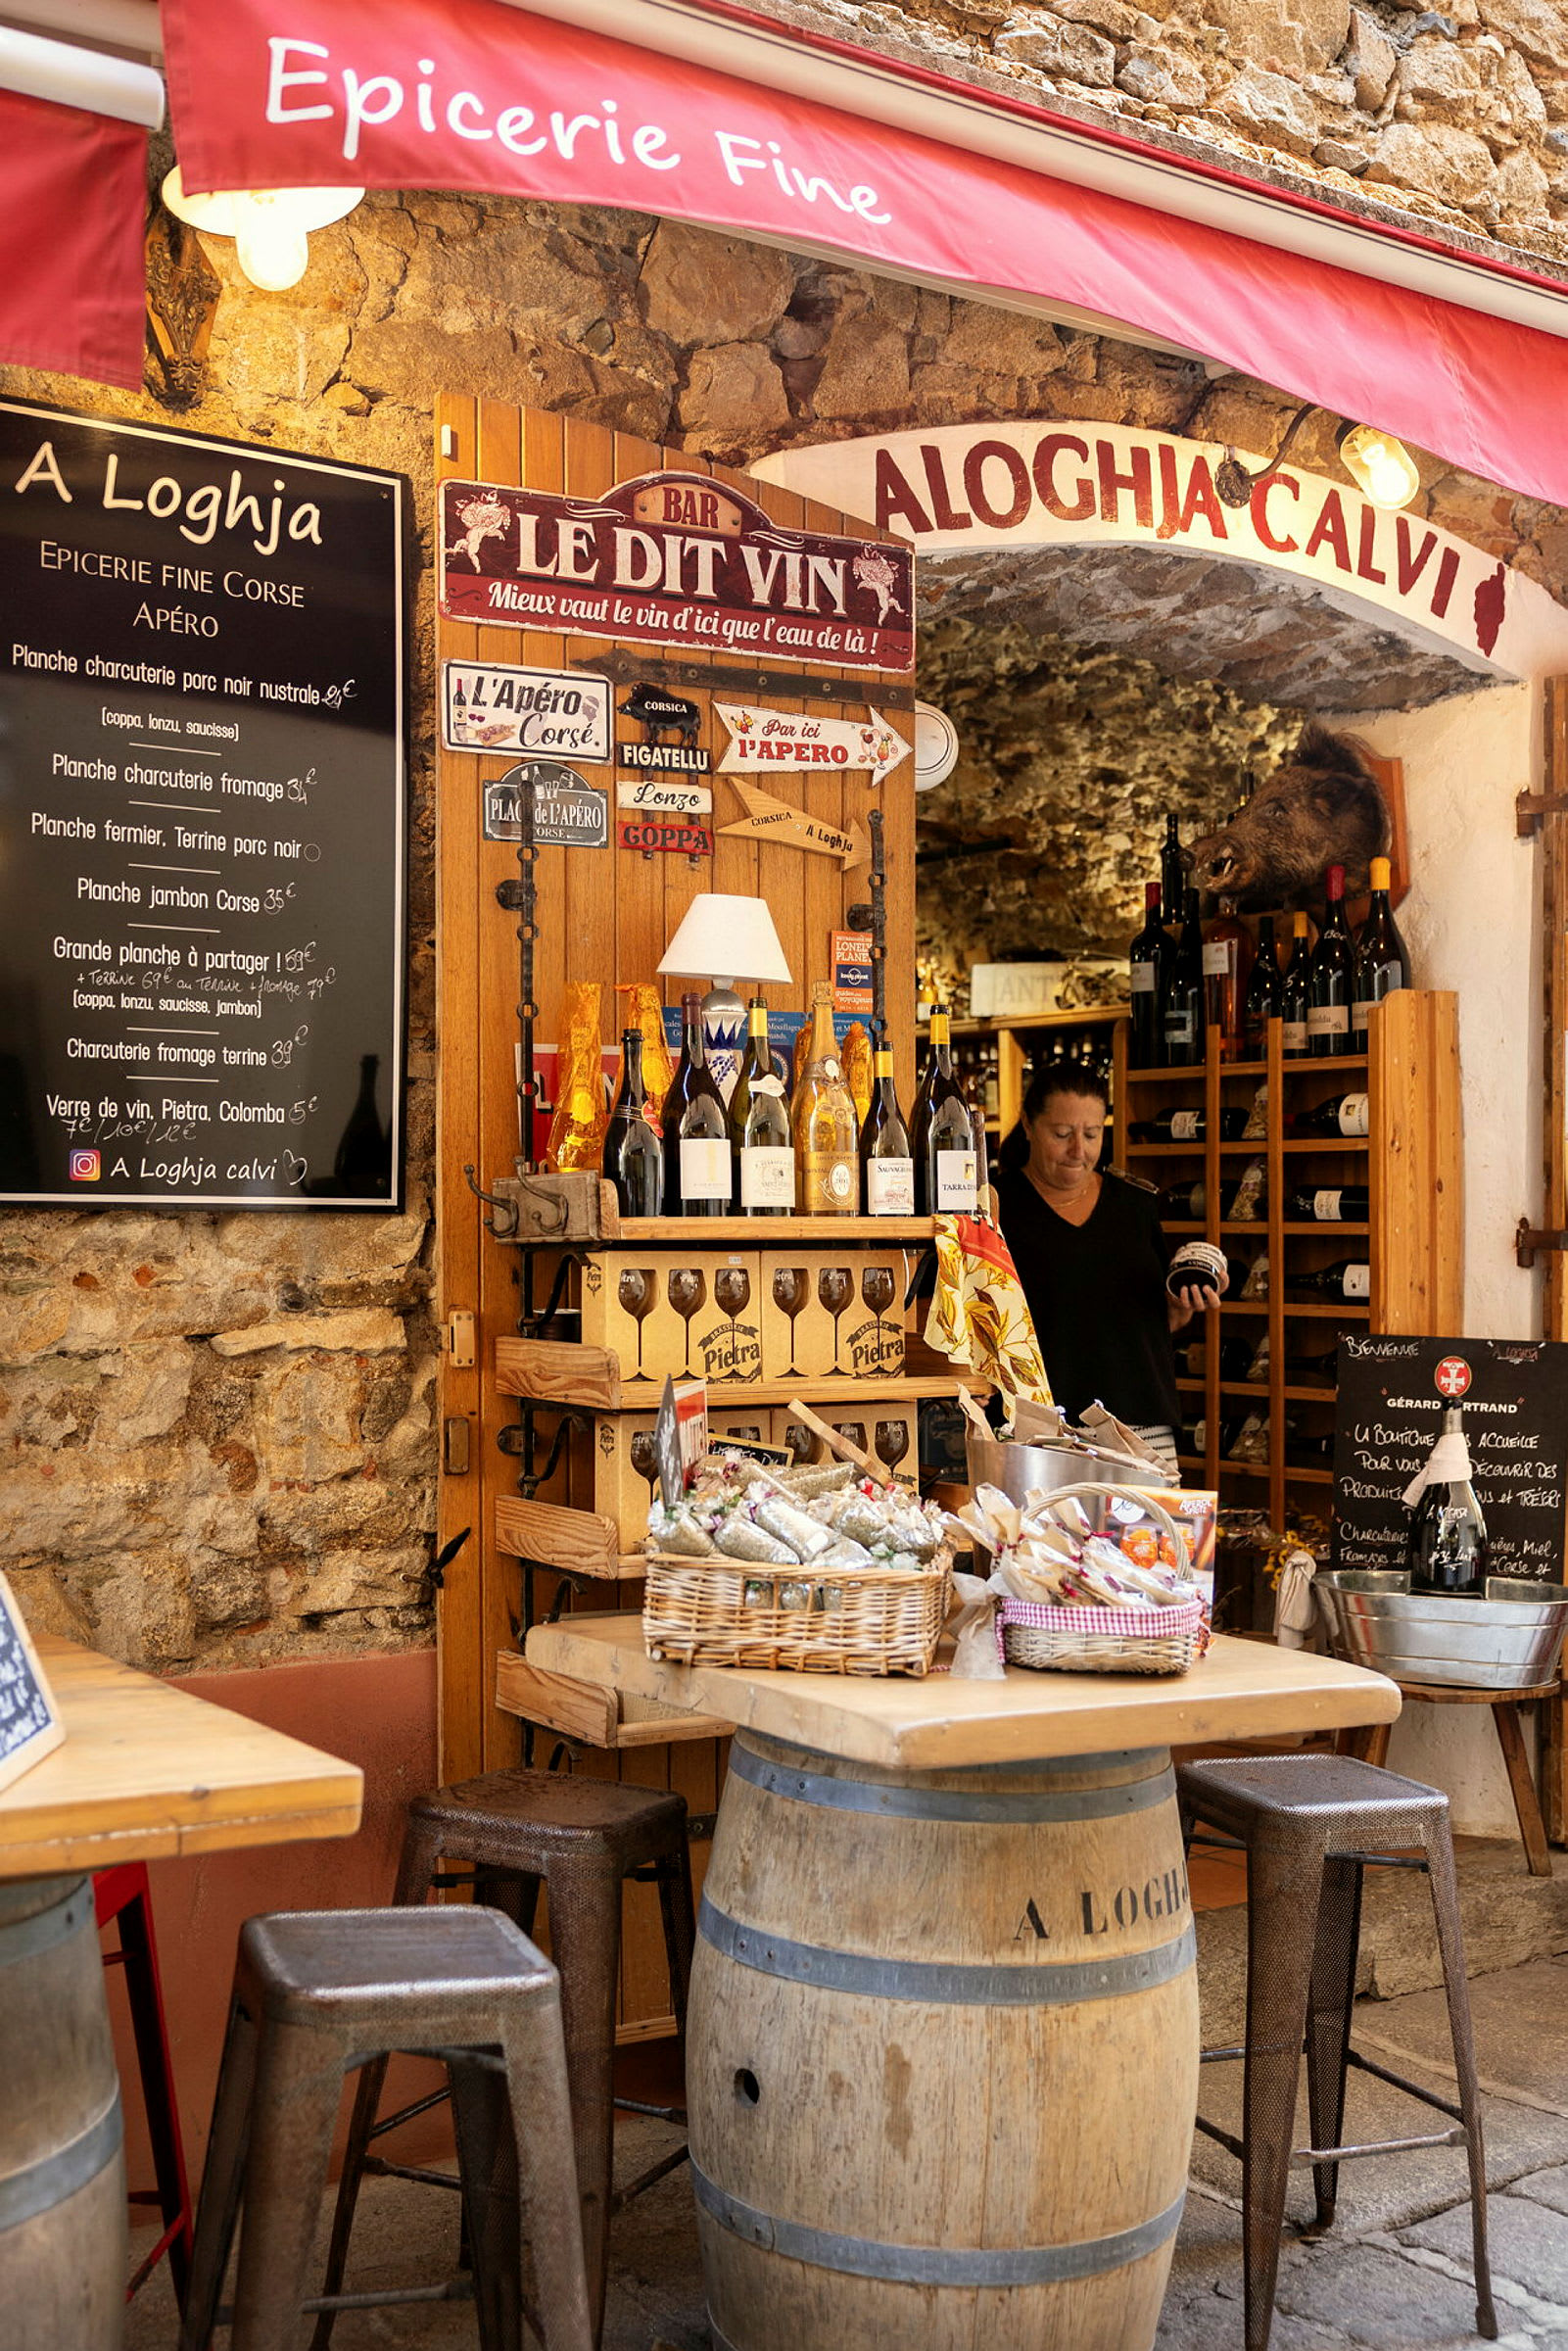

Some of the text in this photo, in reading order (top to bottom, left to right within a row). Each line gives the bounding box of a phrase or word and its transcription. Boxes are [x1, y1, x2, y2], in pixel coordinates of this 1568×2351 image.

[265, 35, 893, 225] Epicerie Fine
[15, 441, 323, 555] A Loghja
[663, 486, 719, 529] BAR
[1250, 472, 1460, 619] CALVI
[40, 540, 305, 607] EPICERIE FINE CORSE
[516, 511, 848, 617] LE DIT VIN
[133, 601, 218, 638] APÉRO
[488, 581, 554, 615] Mieux
[559, 598, 609, 624] vaut
[613, 602, 631, 625] le
[636, 604, 669, 629] vin
[723, 619, 760, 645] que
[817, 626, 841, 651] de
[843, 628, 867, 654] là
[12, 644, 320, 705] Planche charcuterie porc noir nustrale
[472, 676, 583, 715] L'Apéro
[644, 701, 688, 713] CORSICA
[762, 718, 821, 739] Par ici
[623, 744, 708, 771] FIGATELLU
[52, 752, 284, 802] Planche charcuterie fromage
[491, 797, 601, 829] PLAC de L'APÉRO
[633, 783, 700, 811] Lonzo
[31, 812, 96, 840] Planche
[174, 826, 226, 852] Terrine
[234, 836, 266, 859] porc
[273, 840, 302, 859] noir
[535, 827, 565, 838] ORSE
[751, 811, 793, 827] CORSICA
[806, 824, 814, 837] A
[77, 878, 260, 913] Planche jambon Corse
[53, 936, 113, 962] Grande
[119, 941, 181, 967] planche
[188, 945, 198, 967] à
[205, 949, 269, 975] partager
[67, 1037, 267, 1067] Charcuterie fromage terrine
[46, 1094, 90, 1119] Verre
[98, 1096, 118, 1119] de
[219, 1100, 285, 1124] Colomba
[110, 1157, 278, 1185] A Loghja calvi
[704, 1342, 760, 1373] Pietra
[851, 1338, 905, 1369] Pietra
[1387, 1397, 1518, 1414] GÉRARD RTRAND
[1014, 1896, 1049, 1941] A
